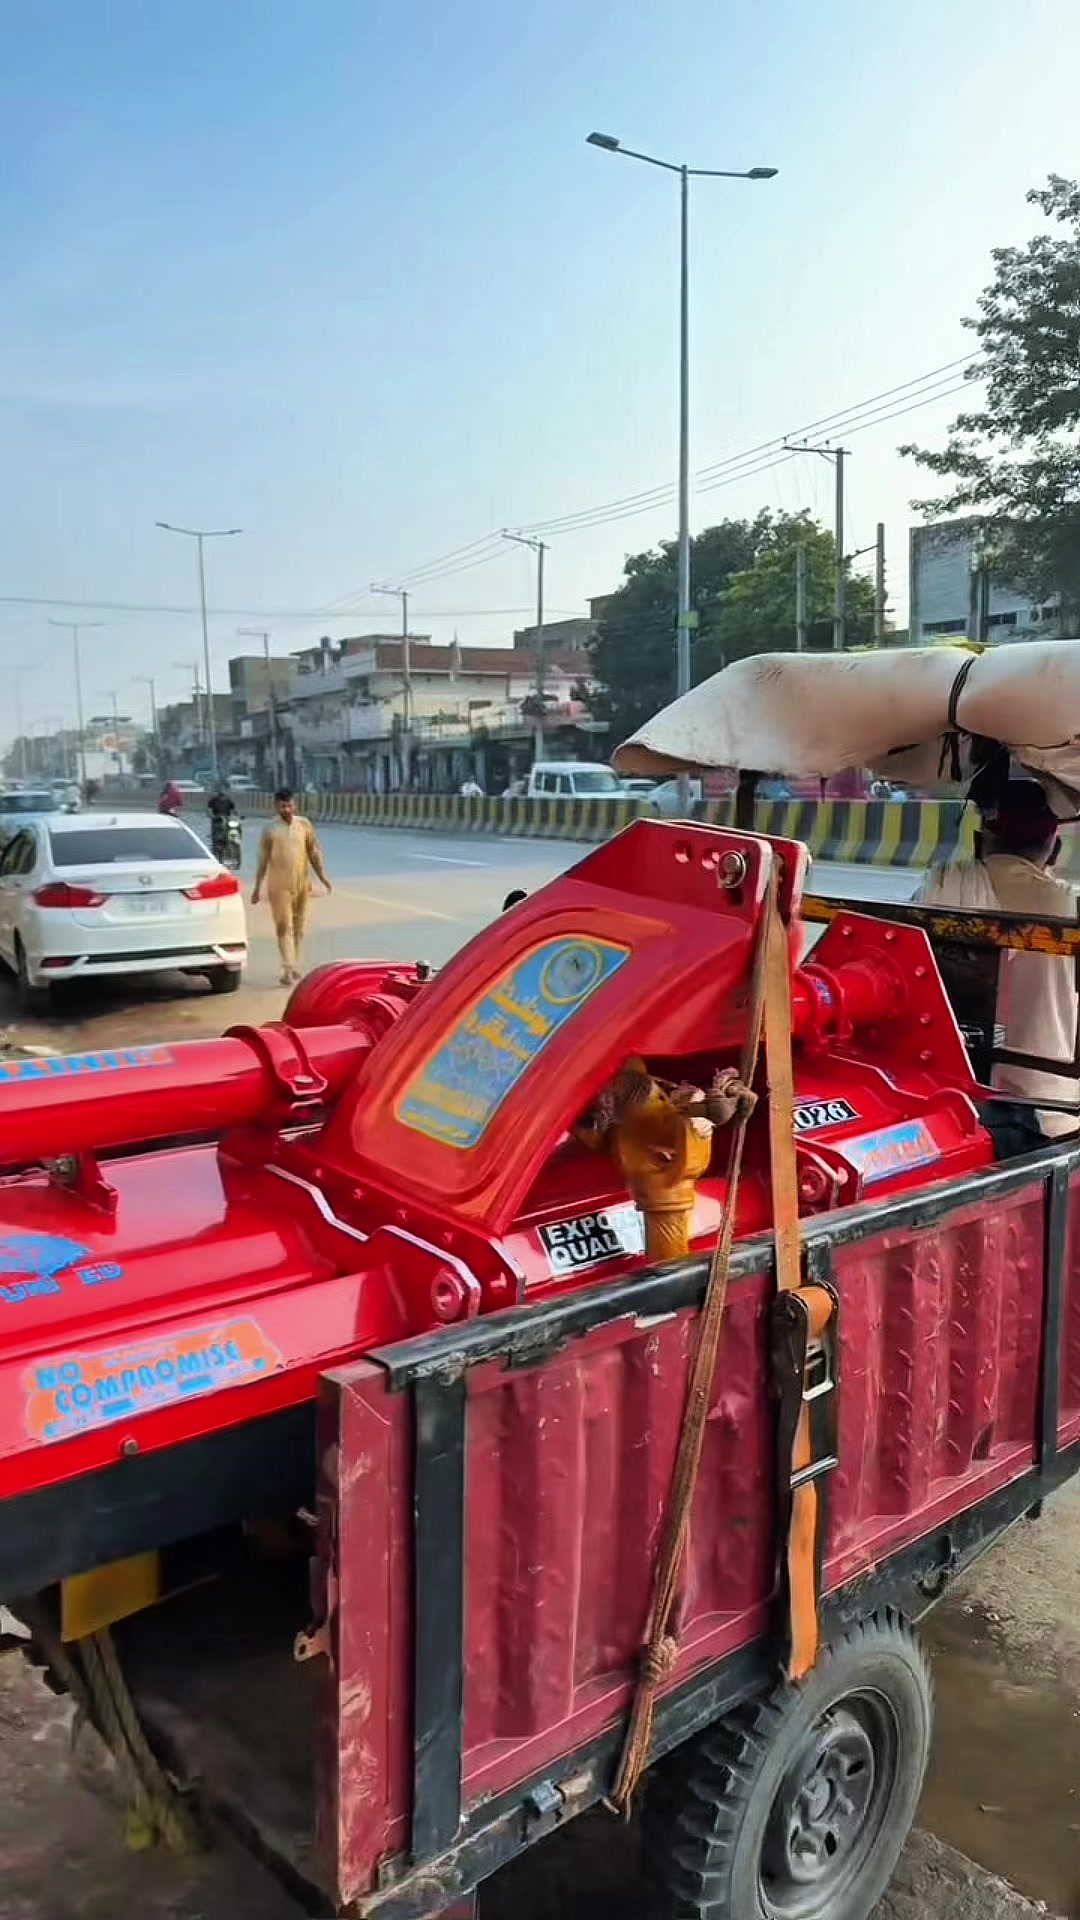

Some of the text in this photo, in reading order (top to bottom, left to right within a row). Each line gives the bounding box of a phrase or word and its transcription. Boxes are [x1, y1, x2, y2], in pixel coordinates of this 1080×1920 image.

[793, 1102, 849, 1131] 026
[36, 1361, 81, 1391] NO
[55, 1340, 240, 1415] COMPROMISE
